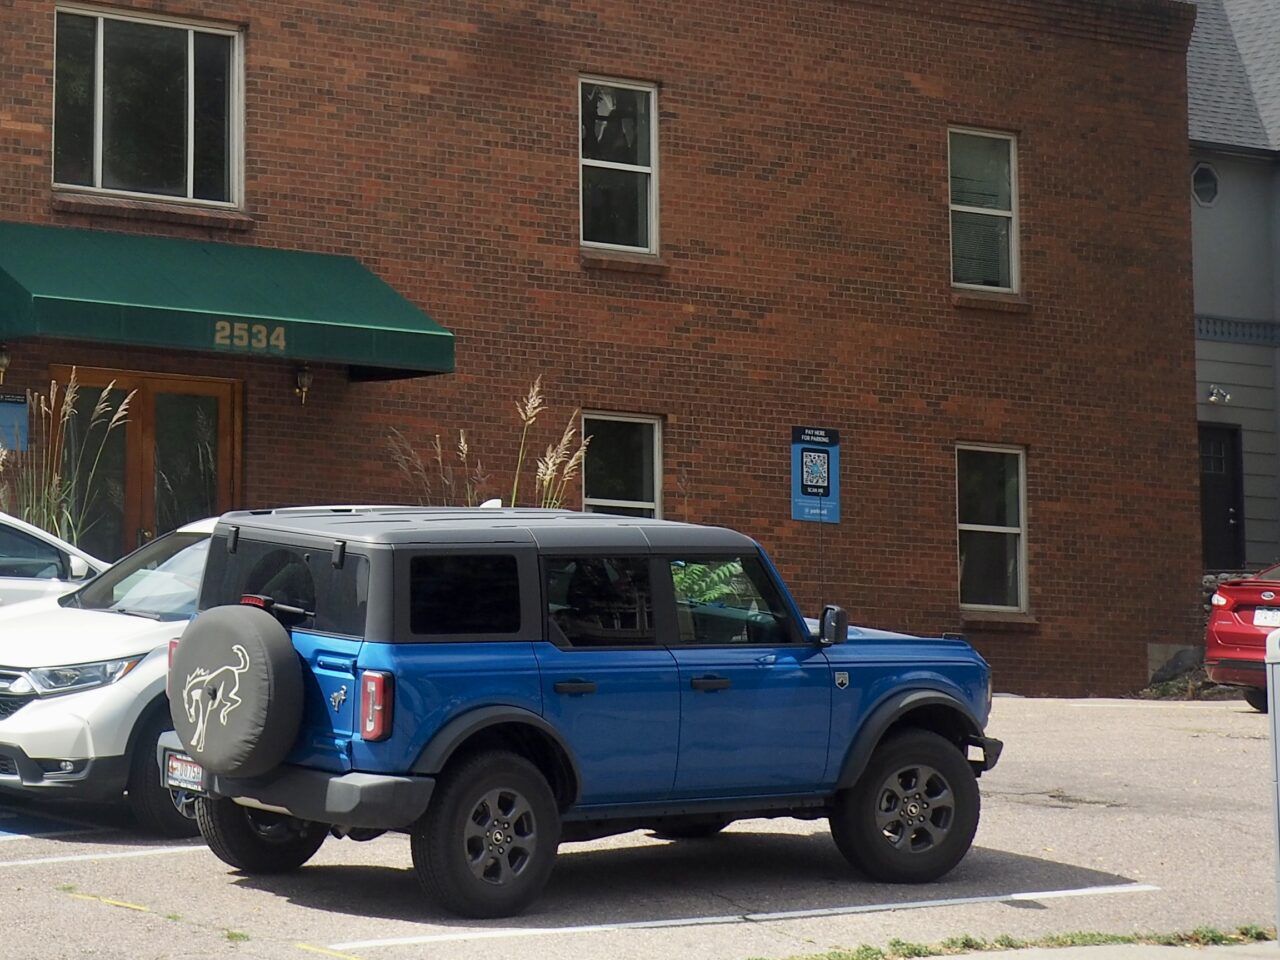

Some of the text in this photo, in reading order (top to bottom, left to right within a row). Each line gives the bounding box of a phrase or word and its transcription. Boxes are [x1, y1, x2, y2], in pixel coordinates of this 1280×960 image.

[214, 320, 286, 351] 2534
[805, 428, 815, 436] PAY
[810, 435, 829, 443] PARKING
